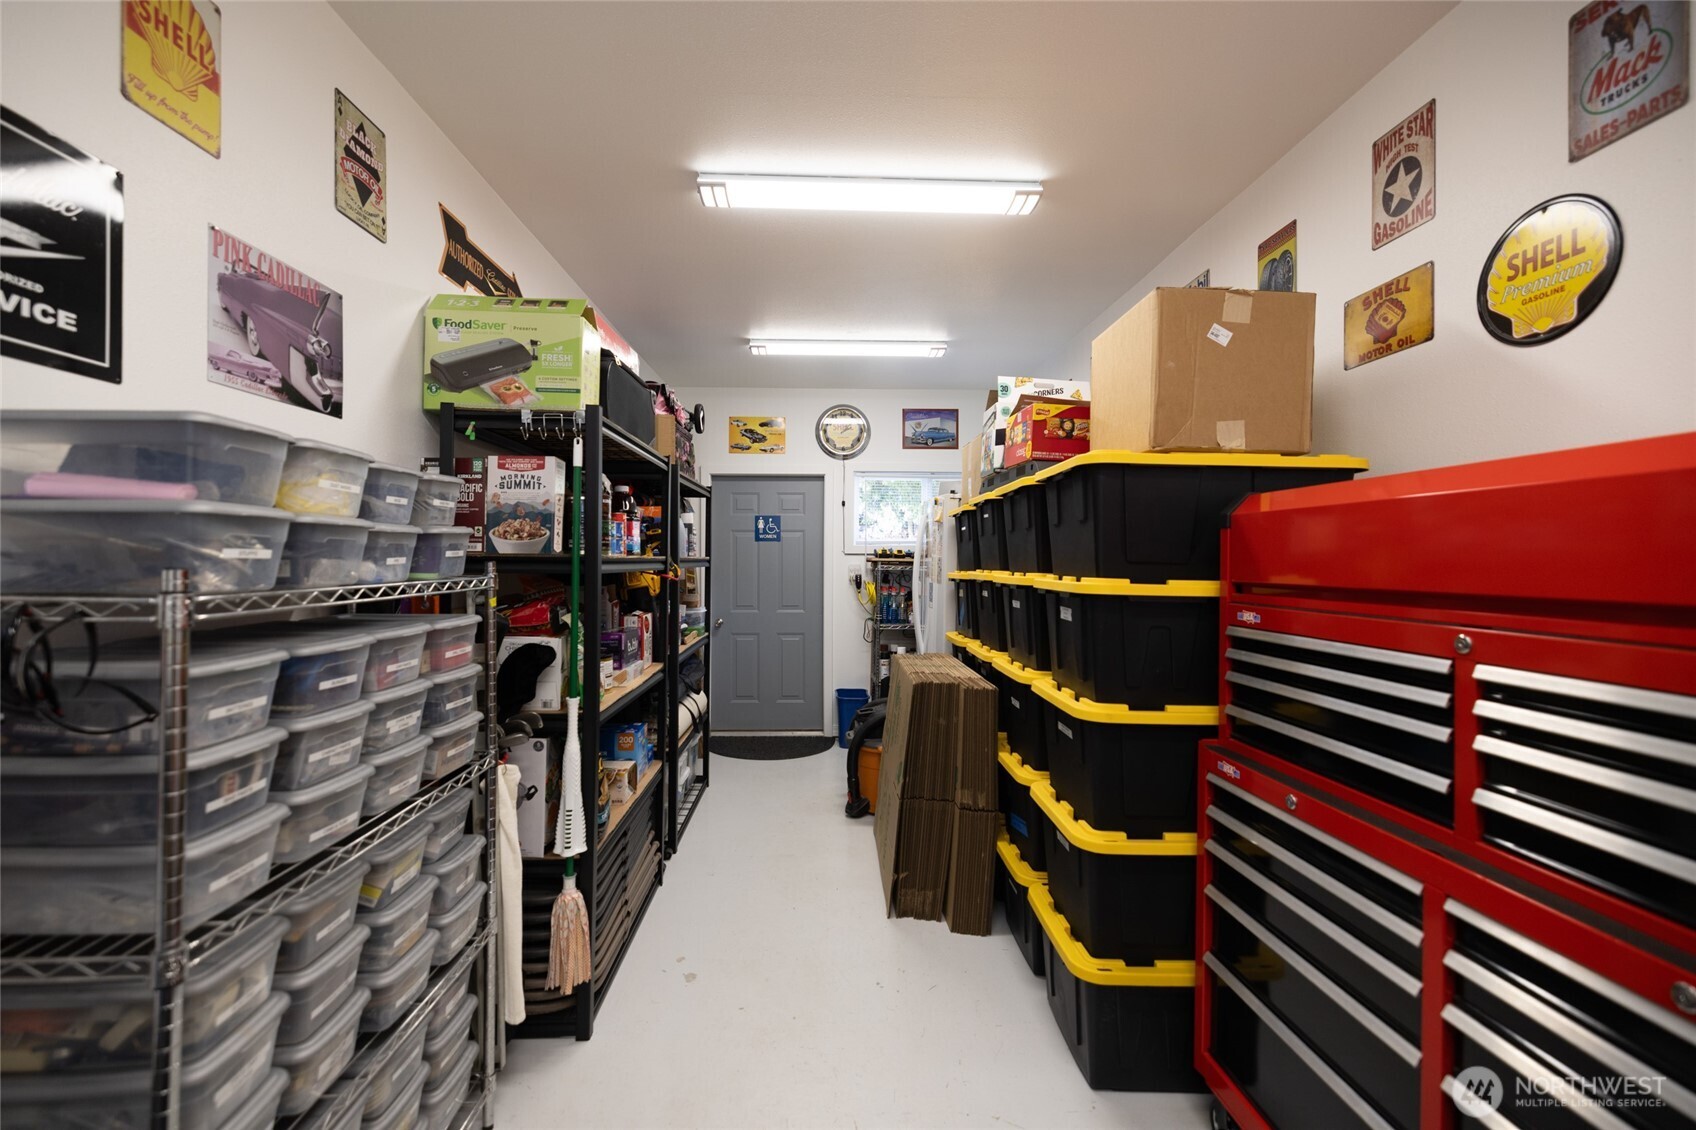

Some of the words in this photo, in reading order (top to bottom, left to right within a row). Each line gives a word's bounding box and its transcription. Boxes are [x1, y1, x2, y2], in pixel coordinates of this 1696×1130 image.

[139, 0, 209, 72] SHELL
[1587, 33, 1663, 104] Mack
[1601, 73, 1649, 107] TRUCKS
[345, 119, 377, 156] BLACK
[1573, 84, 1682, 156] SALES-PARTS
[339, 127, 384, 173] DIAMOND
[1373, 125, 1404, 175] WHITE
[1407, 102, 1433, 140] STAR
[1404, 143, 1419, 154] TEST
[343, 161, 369, 184] MOTOR
[369, 179, 380, 194] OIL
[1373, 187, 1433, 246] GASOLINE
[212, 228, 252, 273] PINK
[257, 252, 320, 308] CADILLAC
[449, 238, 484, 280] AUTHORIZED
[1506, 228, 1586, 282] SHELL
[1362, 277, 1411, 312] SHELL
[1500, 260, 1593, 305] Premium
[1522, 285, 1566, 306] GASOLINE
[444, 318, 506, 330] FoodSaver
[1358, 343, 1393, 363] MOTOR
[1397, 335, 1416, 348] OIL
[1000, 385, 1009, 393] 30
[459, 483, 483, 493] ACIFIC
[499, 480, 542, 490] SUMMIT
[500, 474, 542, 482] MORNING
[618, 736, 634, 744] 200
